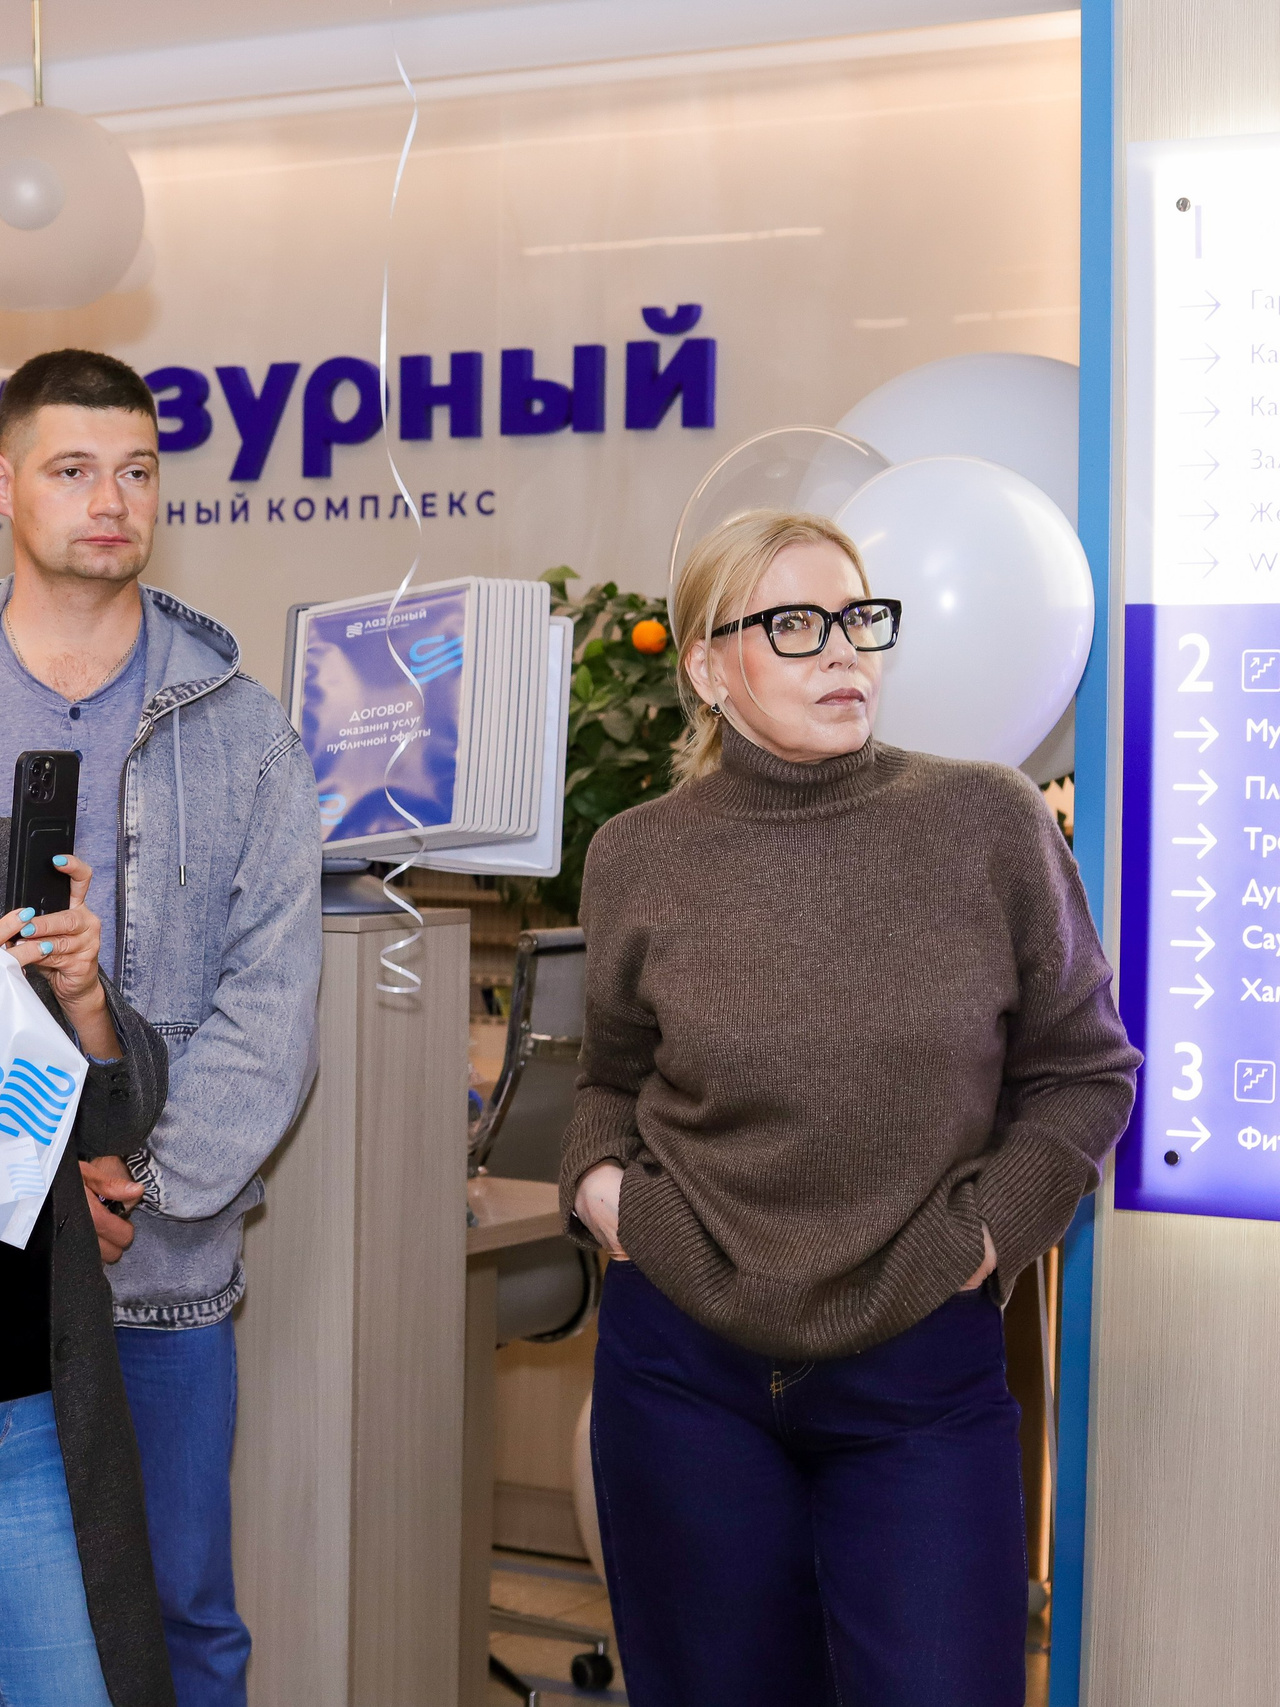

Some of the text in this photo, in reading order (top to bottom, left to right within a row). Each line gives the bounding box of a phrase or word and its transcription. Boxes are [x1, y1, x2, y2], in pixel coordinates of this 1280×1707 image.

[1251, 289, 1280, 316] Га
[1250, 448, 1280, 470] За
[267, 490, 496, 524] КОМПЛЕКС
[1177, 632, 1214, 693] 2
[349, 701, 414, 722] ДОГОВОР
[338, 721, 389, 737] оказания
[1246, 718, 1280, 750] Му
[326, 733, 388, 755] публичной
[1245, 775, 1280, 800] Пл
[1243, 826, 1280, 858] Тр
[1241, 878, 1280, 910] Ду
[1172, 1041, 1203, 1101] 3
[1237, 1126, 1280, 1152] Фи
